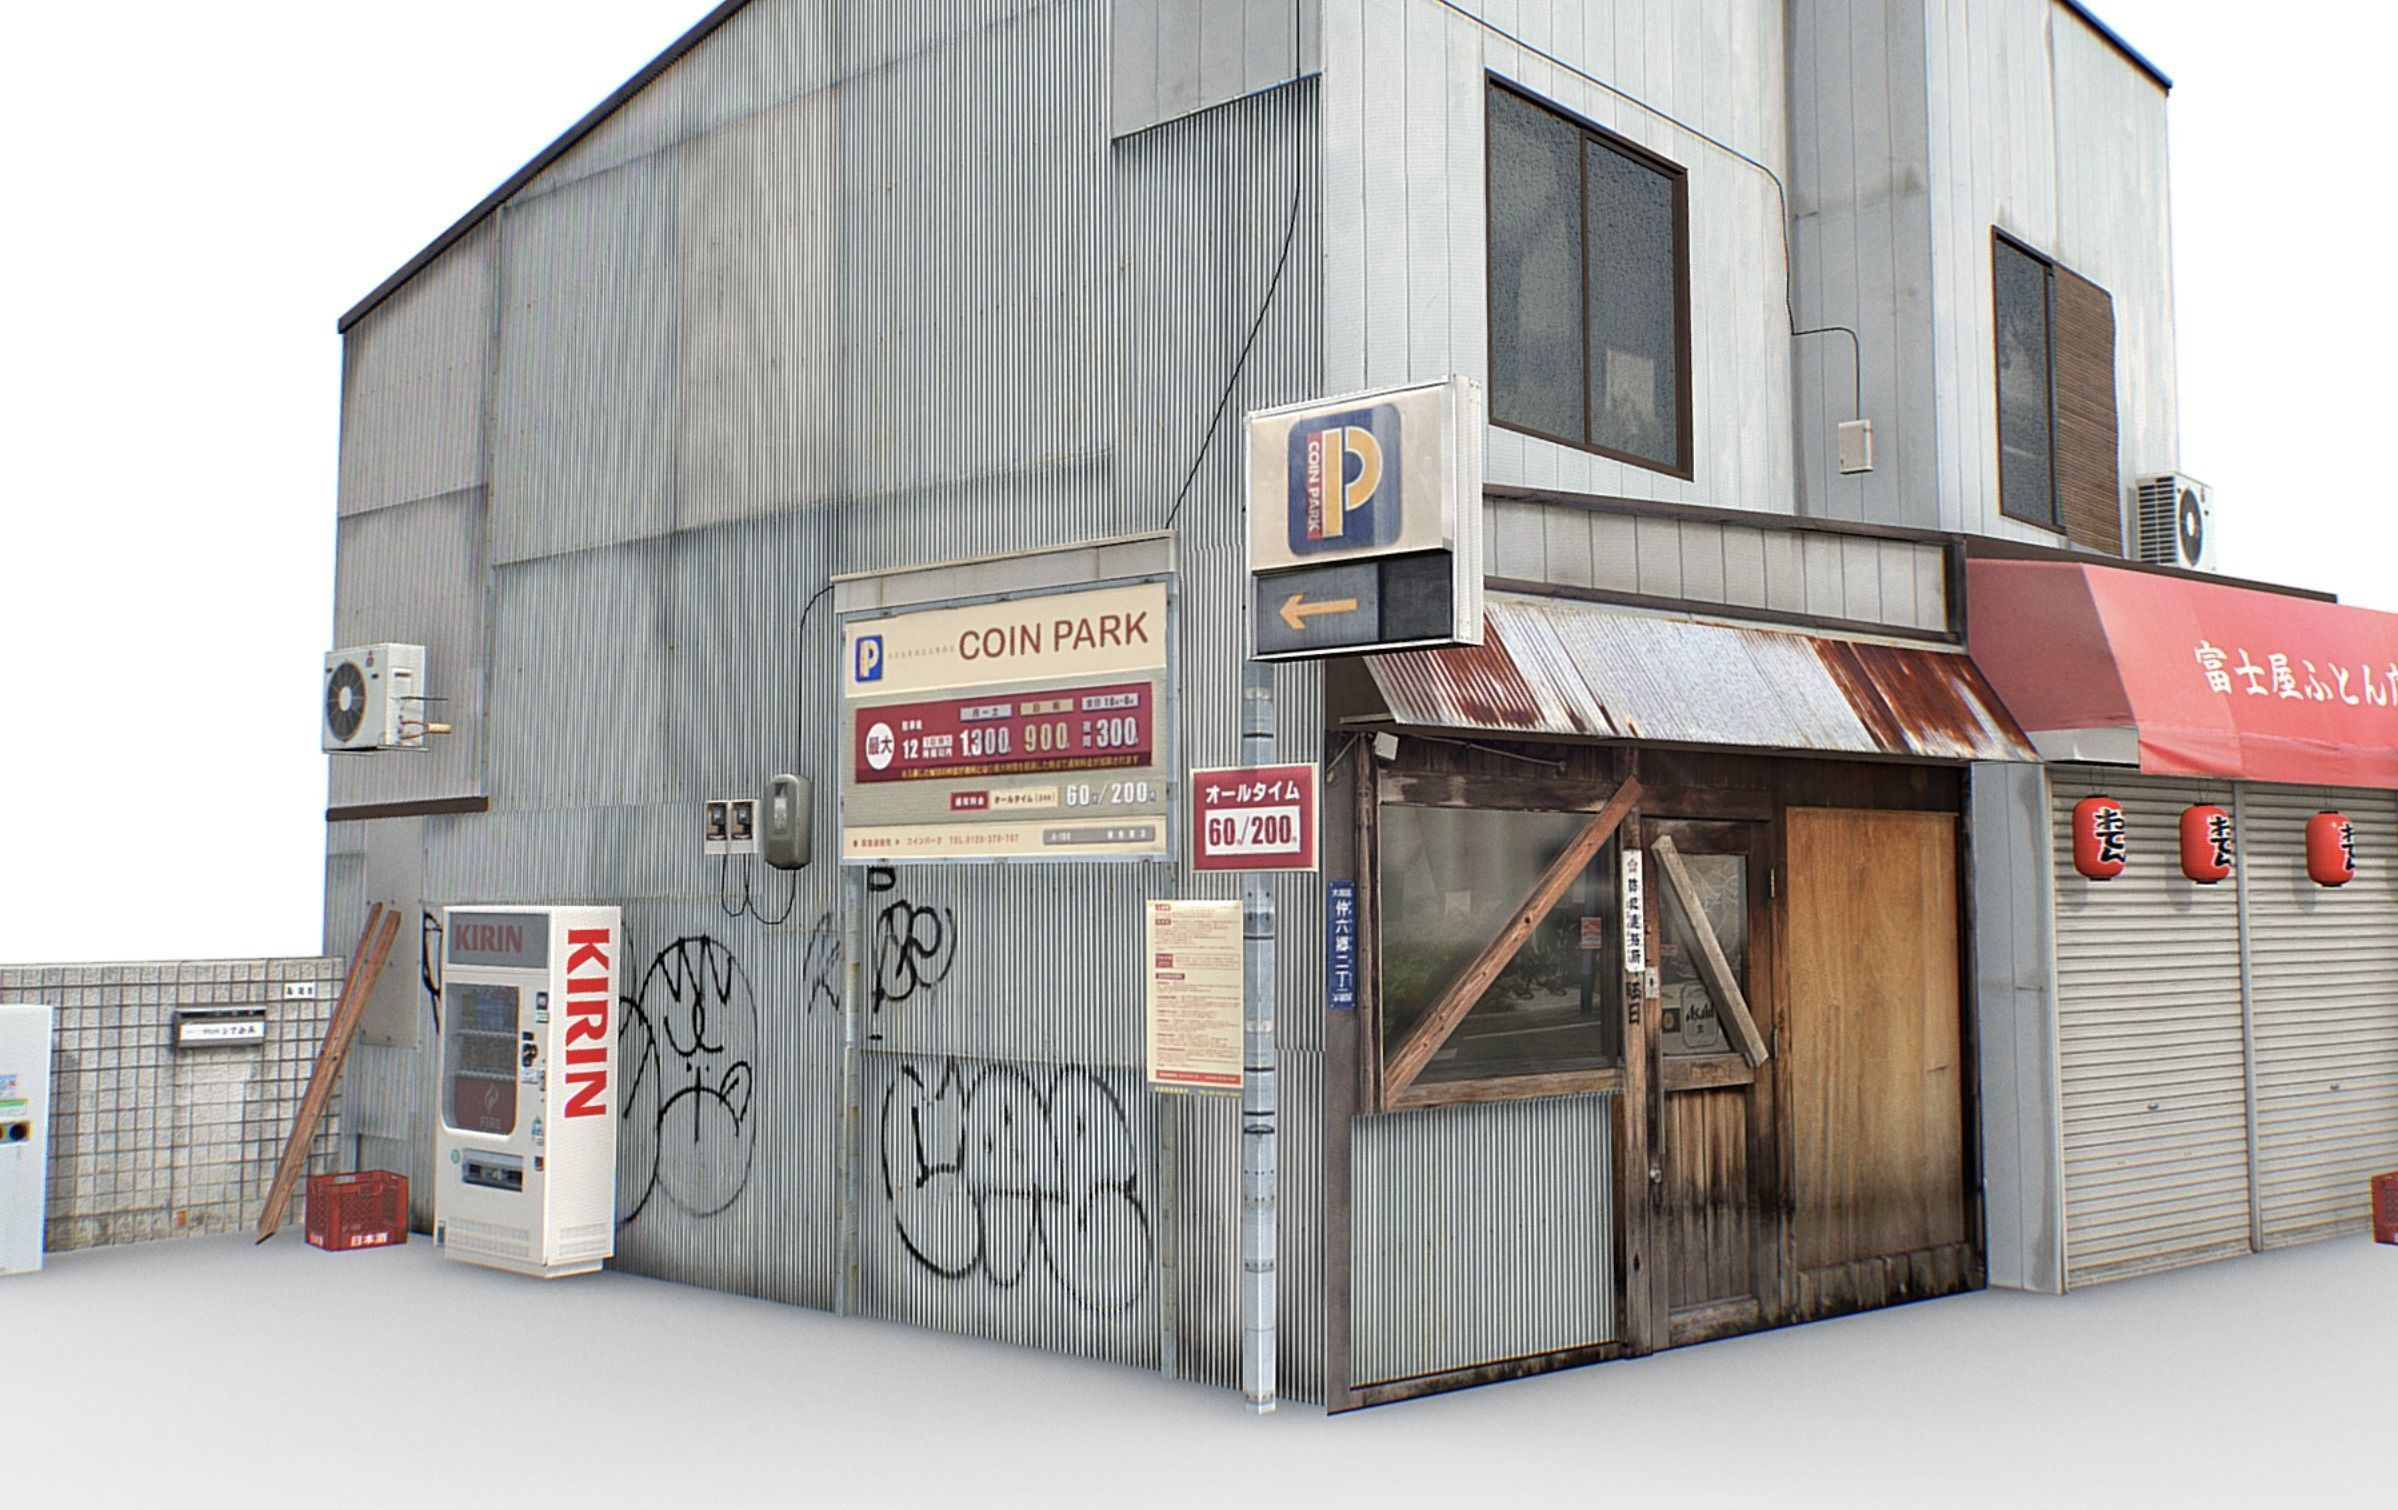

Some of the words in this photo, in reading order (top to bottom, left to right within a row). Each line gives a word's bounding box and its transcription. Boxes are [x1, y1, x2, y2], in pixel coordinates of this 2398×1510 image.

[1308, 441, 1320, 484] COIN
[1308, 487, 1320, 532] PARK
[959, 623, 1041, 660] COIN
[1054, 611, 1148, 652] PARK
[868, 736, 892, 755] 最大
[903, 739, 919, 759] 12
[1206, 780, 1300, 804] オールタイム
[455, 924, 523, 954] KIRIN
[564, 928, 610, 1119] KIRIN
